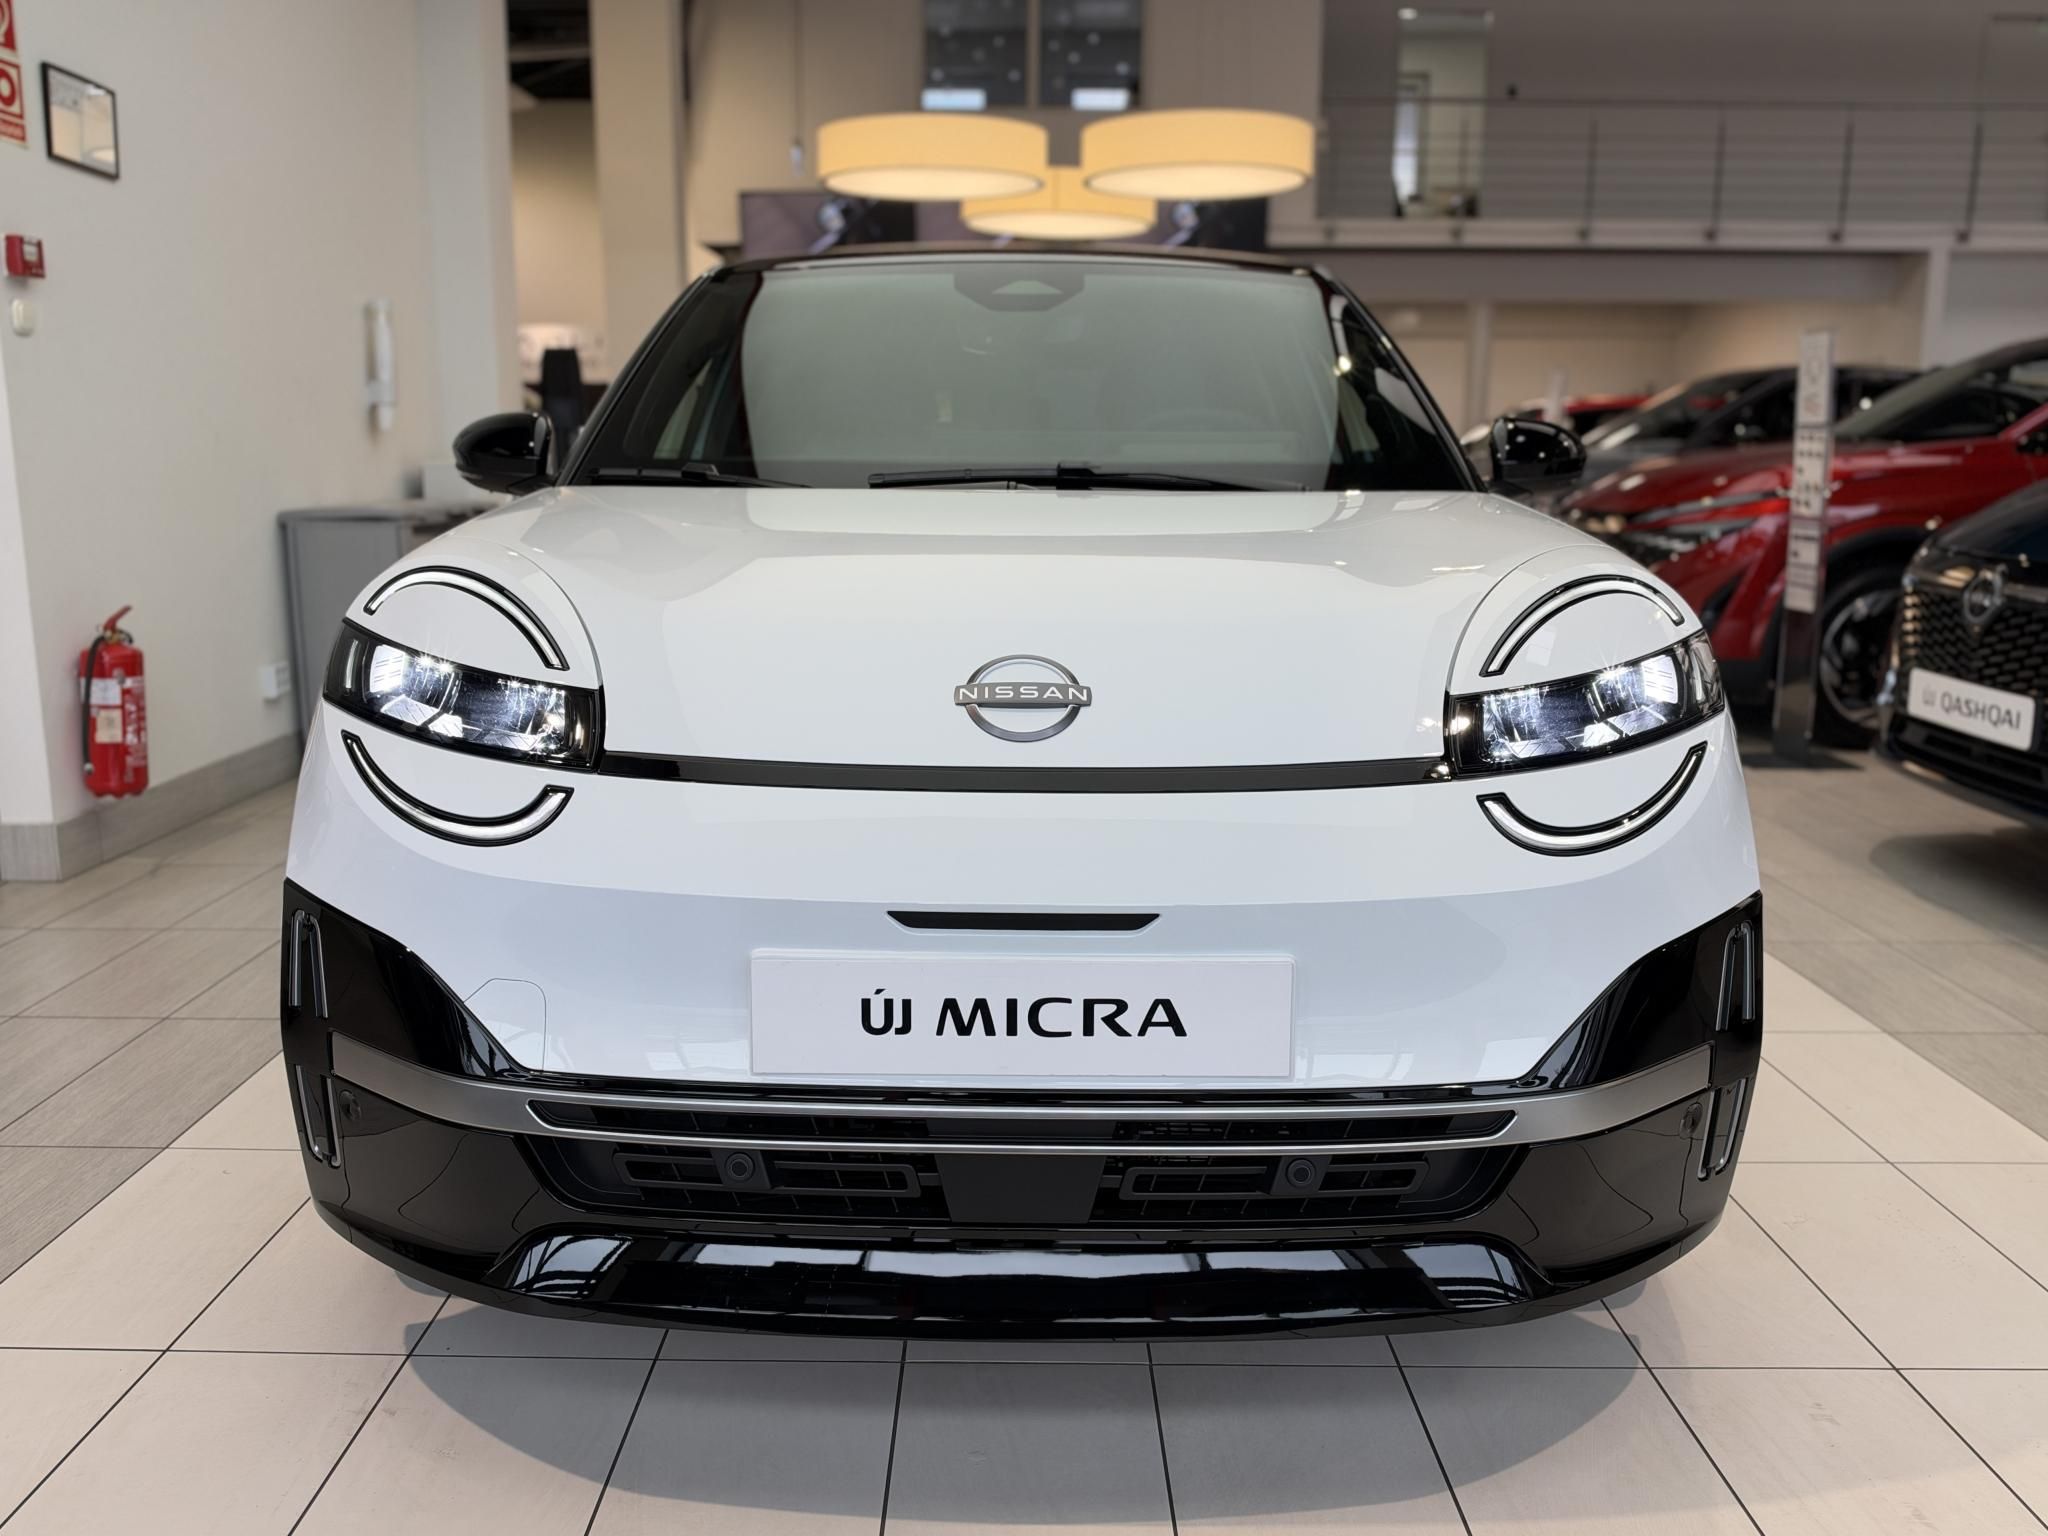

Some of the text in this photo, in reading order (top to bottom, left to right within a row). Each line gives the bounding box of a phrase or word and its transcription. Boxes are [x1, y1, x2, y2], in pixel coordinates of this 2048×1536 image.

[959, 686, 1088, 701] NISSAN
[1940, 691, 2022, 730] QASHQAI
[861, 988, 1188, 1038] ÚJ MICRA
